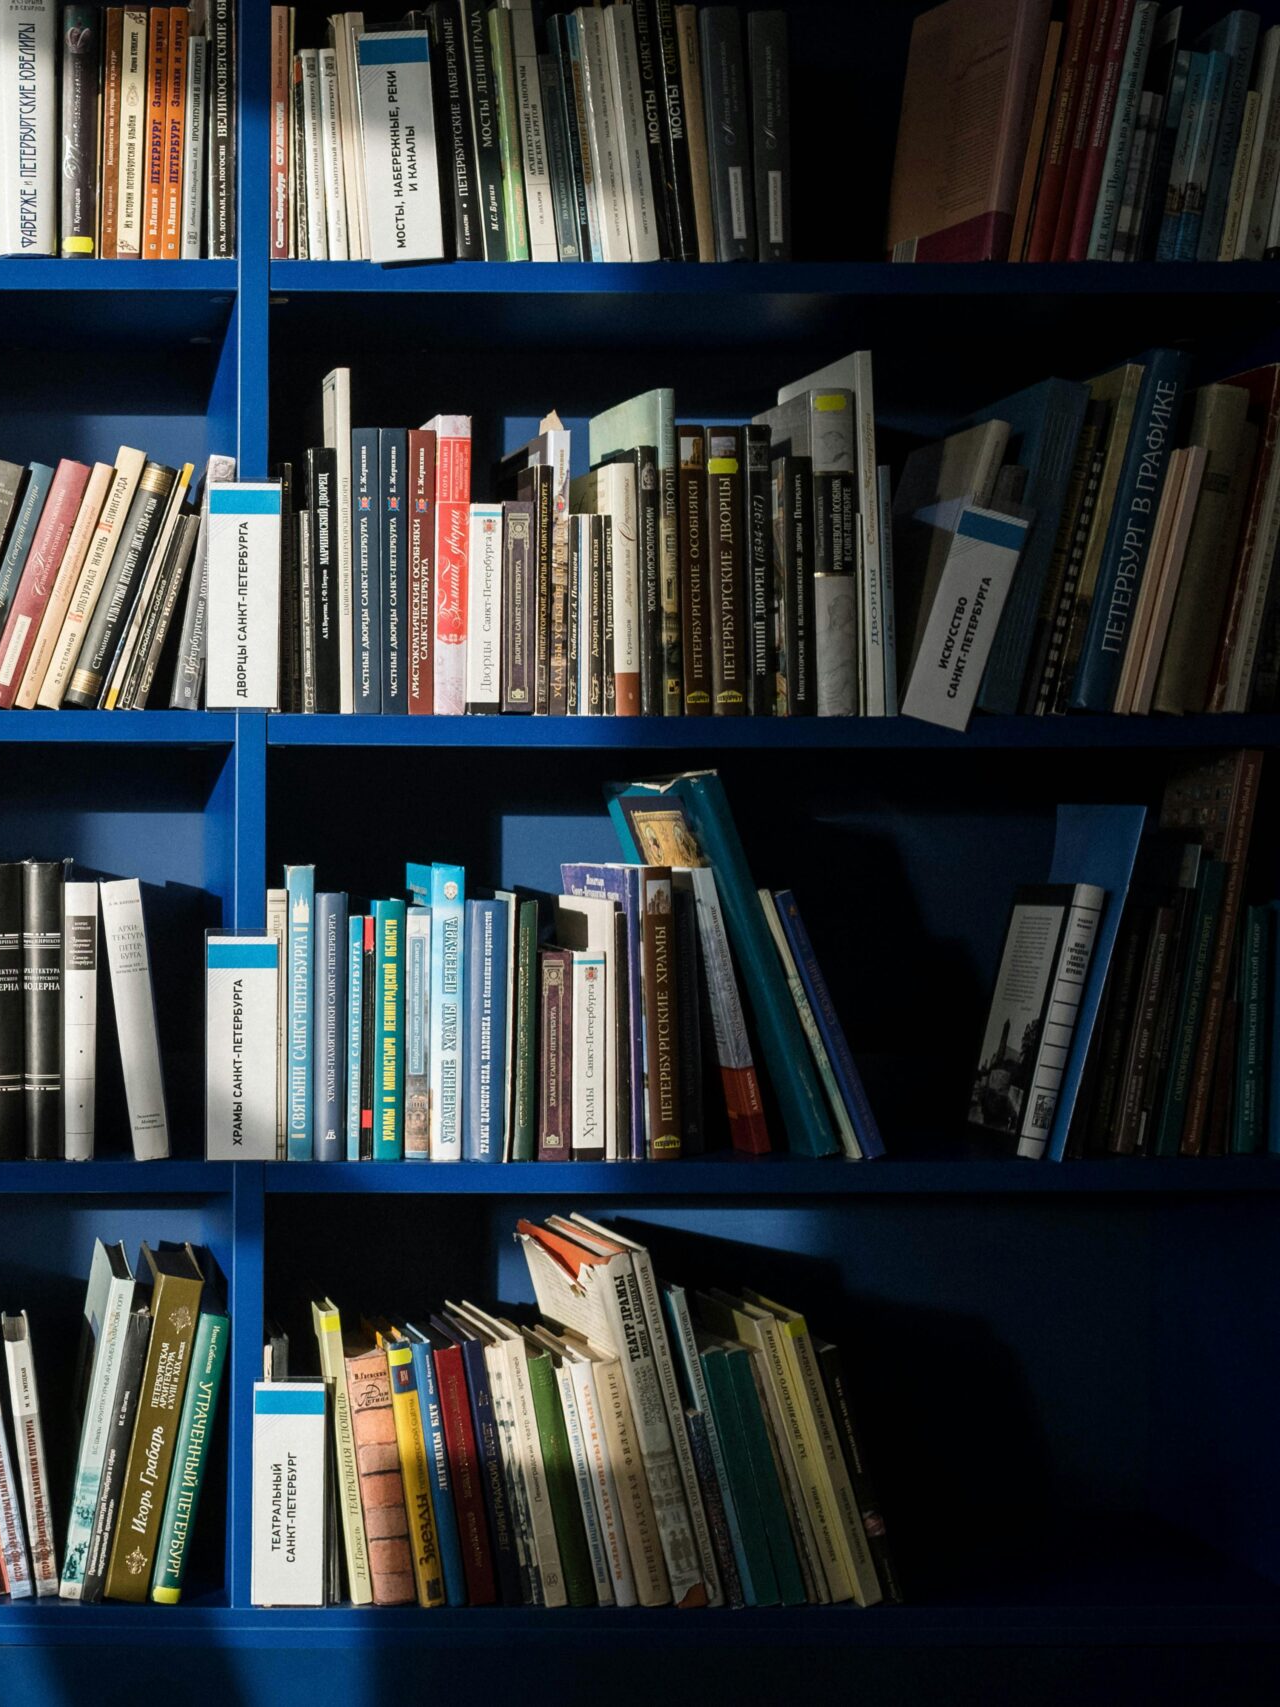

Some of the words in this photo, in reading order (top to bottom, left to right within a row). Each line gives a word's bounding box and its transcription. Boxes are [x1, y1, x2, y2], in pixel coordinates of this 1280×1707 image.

[19, 23, 36, 81] ЮВЕЛИРЫ
[155, 20, 163, 52] звуки
[173, 19, 183, 52] звуки
[442, 17, 460, 98] НАБЕРЕЖНЫЕ
[471, 10, 488, 94] ЛЕНИНГРАДА
[152, 69, 162, 107] Запахи
[170, 68, 181, 107] Запахи
[217, 23, 228, 137] ВЕЛИКОСВЕТСКИЕ
[387, 70, 397, 103] РЕКИ
[19, 84, 37, 177] ПЕТЕРБУРГСКИЕ
[481, 99, 493, 147] МОСТЫ
[645, 89, 661, 144] МОСТЫ
[668, 84, 683, 139] МОСТЫ
[151, 119, 162, 184] ПЕТЕРБУРГ
[170, 119, 180, 184] ПЕТЕРБУРГ
[389, 106, 404, 197] НАБЕРЕЖНЫЕ,
[404, 126, 417, 179] КАНАЛЫ
[451, 103, 469, 196] ПЕТЕРБУРГСКИЕ
[409, 182, 418, 191] И
[20, 189, 37, 248] ФАБЕРЖЕ
[395, 201, 406, 248] МОСТЫ,
[360, 445, 368, 484] Жерихина
[389, 445, 398, 484] Жерихина
[1138, 380, 1178, 493] ГРАФИКЕ
[318, 473, 330, 506] ДВОРЕЦ
[688, 480, 700, 558] ОСОБНЯКИ
[719, 477, 733, 544] ДВОРЦЫ
[1131, 497, 1152, 516] В
[318, 508, 330, 565] МАРИИНСКИЙ
[413, 518, 421, 578] ОСОБНЯКИ
[752, 494, 765, 562] (1894-1917)
[237, 522, 249, 641] САНКТ-ПЕТЕРБУРГА
[360, 516, 369, 606] САНКТ-ПЕТЕРБУРГА
[389, 517, 398, 606] САНКТ-ПЕТЕРБУРГА
[482, 536, 494, 632] Санкт-Петербурга
[754, 566, 767, 617] ДВОРЕЦ
[1101, 518, 1146, 654] ПЕТЕРБУРГ
[362, 608, 372, 648] ДВОРЦЫ
[390, 608, 401, 649] ДВОРЦЫ
[420, 558, 429, 660] САНКТ-ПЕТЕРБУРГА
[690, 563, 704, 679] ПЕТЕРБУРГСКИЕ
[720, 550, 736, 680] ПЕТЕРБУРГСКИЕ
[937, 596, 968, 669] ИСКУССТВО
[946, 577, 993, 698] САНКТ-ПЕТЕРБУРГА
[412, 581, 421, 699] АРИСТОКРАТИЧЕСКИЕ
[480, 640, 493, 692] Дворцы
[754, 620, 766, 675] ЗИМНИЙ
[237, 645, 249, 698] ДВОРЦЫ
[362, 651, 370, 696] ЧАСТНЫЕ
[390, 651, 398, 696] ЧАСТНЫЕ
[327, 913, 337, 1004] САНКТ-ПЕТЕРБУРГА
[384, 919, 398, 957] ОБЛАСТИ
[441, 916, 459, 994] ПЕТЕРБУРГА
[655, 925, 669, 983] ХРАМЫ
[292, 935, 308, 1060] САНКТ-ПЕТЕРБУРГА
[381, 963, 398, 1031] ЛЕНИНГРАДСКОЙ
[441, 1003, 457, 1050] ХРАМЫ
[232, 979, 243, 1098] САНКТ-ПЕТЕРБУРГА
[327, 1005, 336, 1103] ХРАМЫ-ПАМЯТНИКИ
[584, 983, 597, 1079] Санкт-Петербурга
[656, 991, 674, 1122] ПЕТЕРБУРГСКИЕ
[383, 1038, 396, 1090] МОНАСТЫРИ
[232, 1101, 243, 1145] ХРАМЫ
[292, 1066, 307, 1129] СВЯТЫНИ
[382, 1108, 396, 1141] ХРАМЫ
[441, 1059, 457, 1144] УТРАЧЕННЫЕ
[583, 1087, 597, 1137] Храмы
[613, 1274, 635, 1321] ДРАМЫ
[622, 1322, 642, 1362] ТЕАТР
[150, 1341, 170, 1409] ПЕТЕРБУРГСКАЯ
[159, 1351, 177, 1409] АРХИТЕКТУРА
[181, 1380, 214, 1487] УТРАЧЕННЫЙ
[335, 1392, 351, 1444] ПЛОЩАДЬ
[427, 1402, 441, 1428] БДТ
[606, 1371, 633, 1466] ФИЛАРМОНИЯ
[140, 1425, 165, 1486] Грабарь
[342, 1447, 359, 1517] ТЕАТРАЛЬНАЯ
[430, 1431, 449, 1491] ЛЕГЕНДЫ
[131, 1489, 152, 1534] Игорь
[165, 1490, 194, 1577] ПЕТЕРБУРГ
[270, 1463, 282, 1551] ТЕАТРАЛЬНЫЙ
[285, 1452, 297, 1563] САНКТ-ПЕТЕРБУРГ
[628, 1474, 661, 1592] ЛЕНИНГРАДСКАЯ
